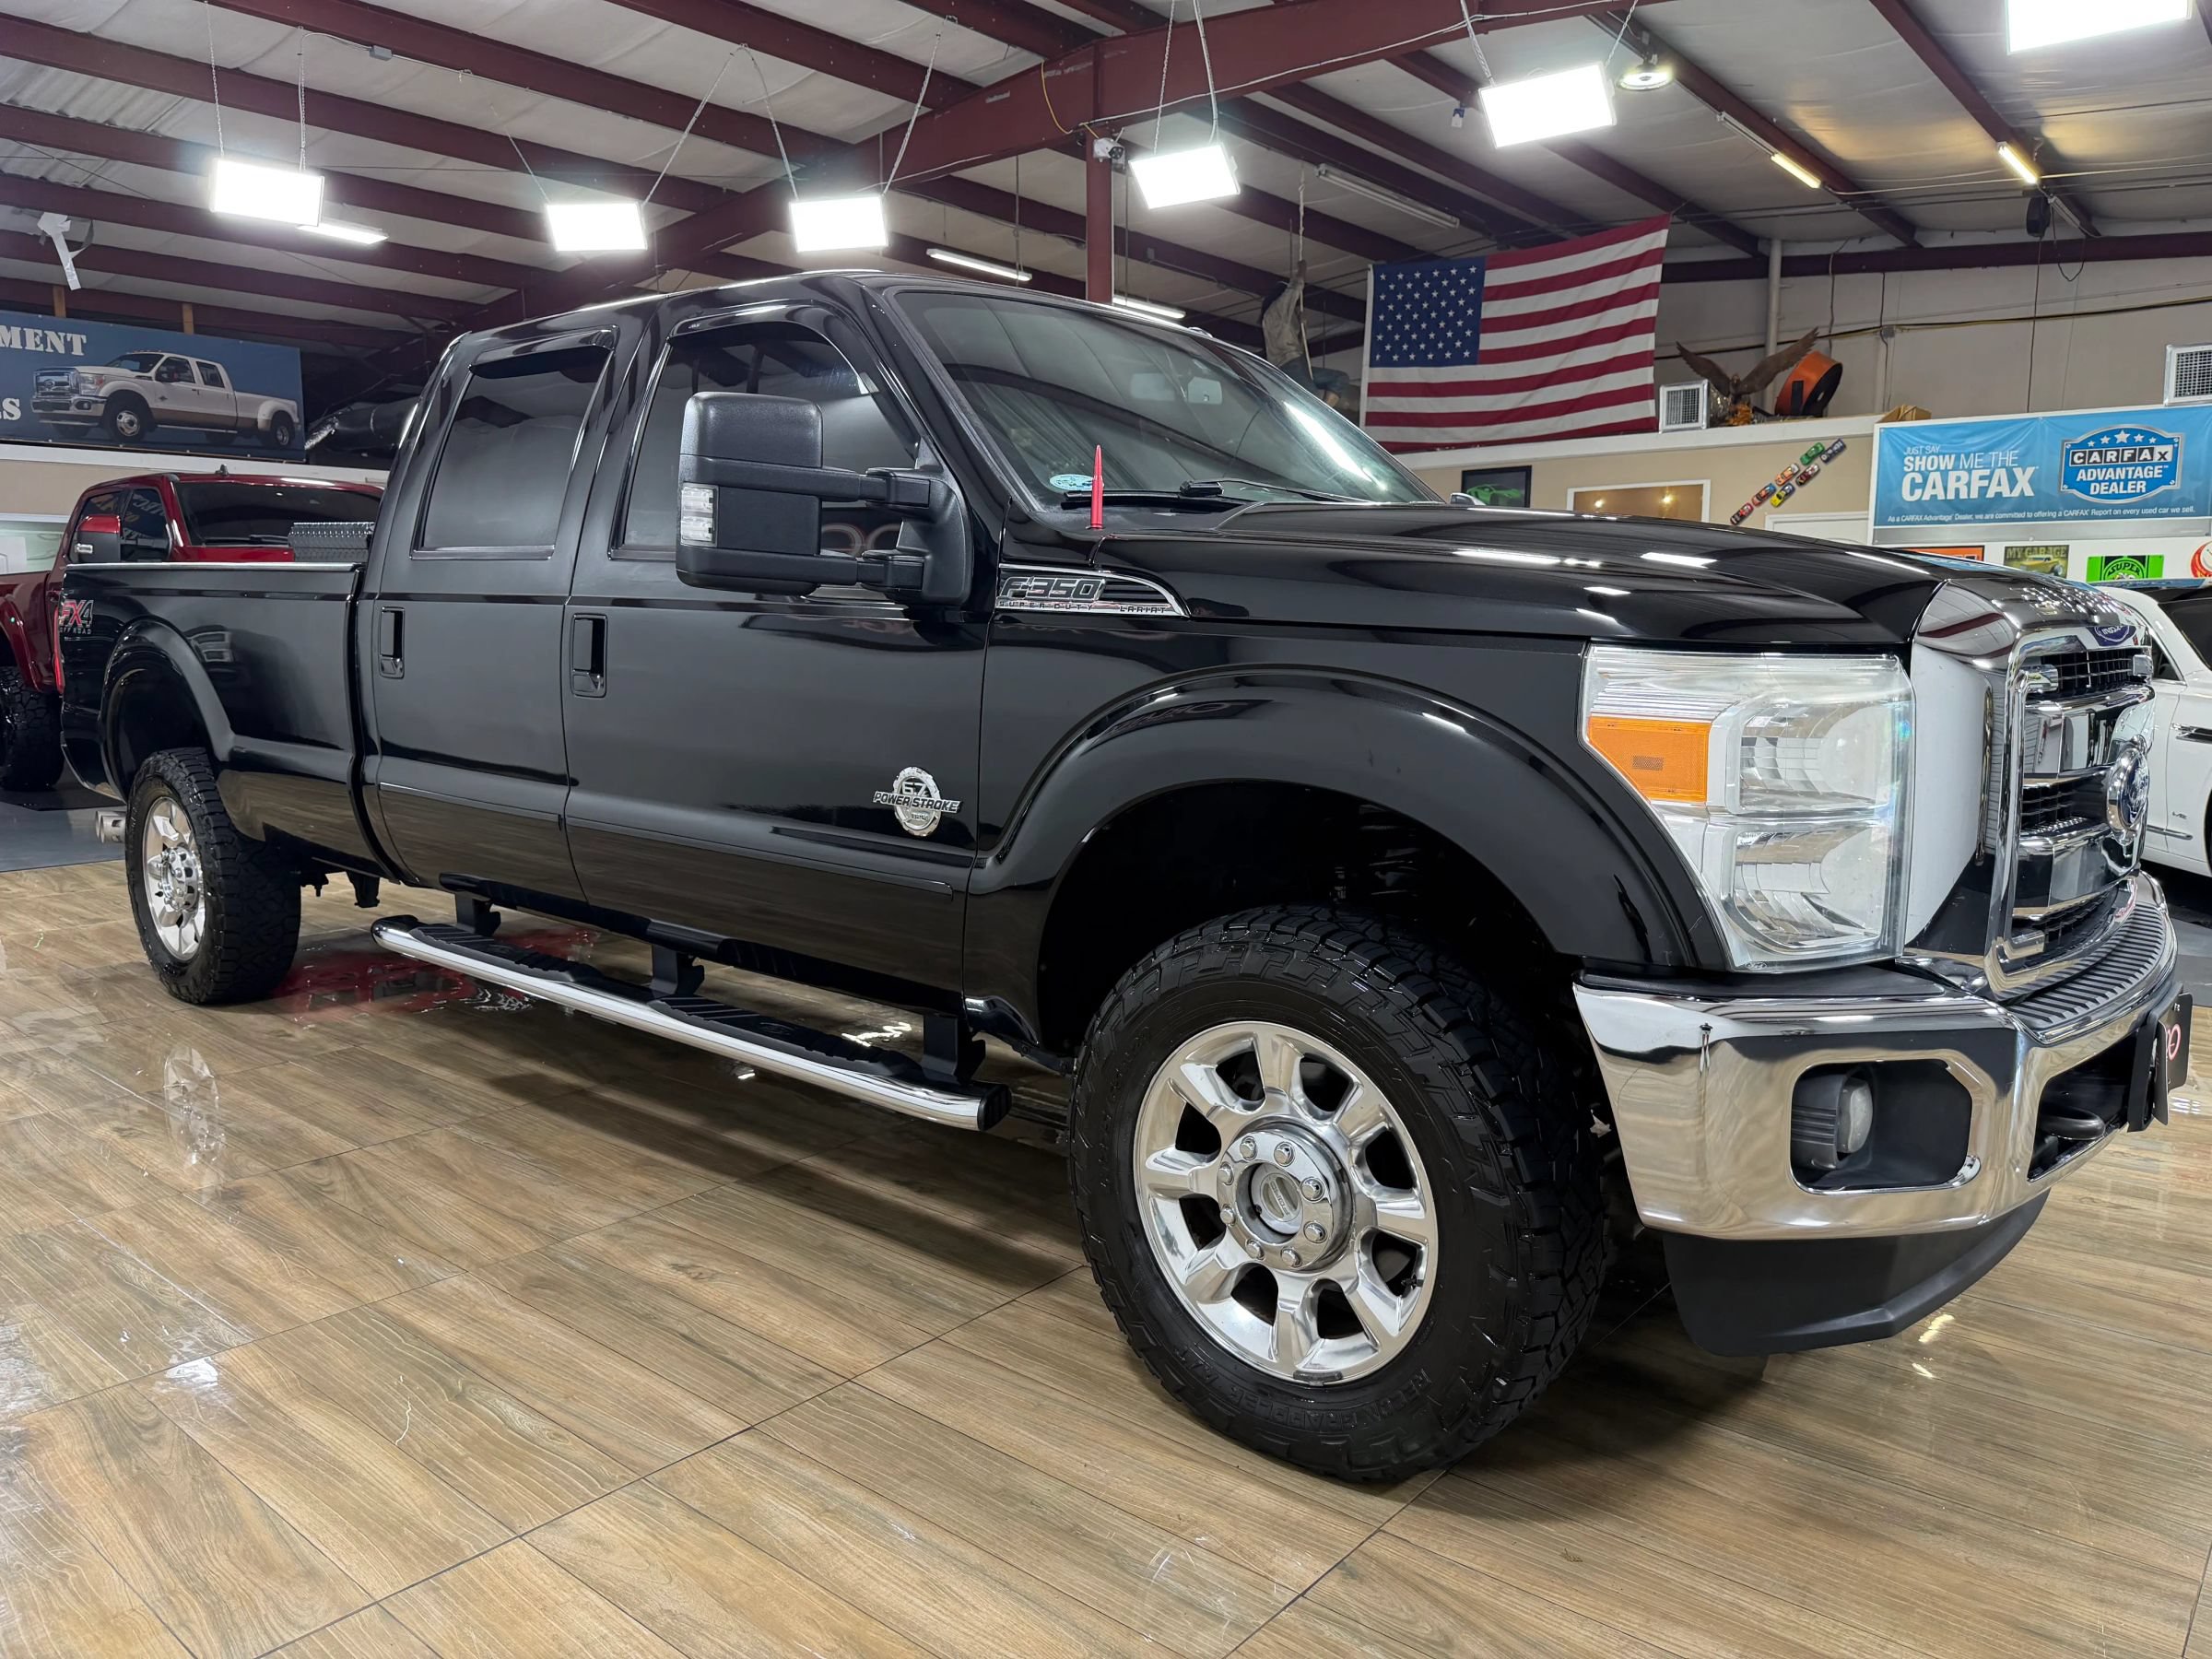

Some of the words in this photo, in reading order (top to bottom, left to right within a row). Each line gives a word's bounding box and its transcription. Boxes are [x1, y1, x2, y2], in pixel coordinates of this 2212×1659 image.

[1903, 445, 1924, 455] JUST
[1925, 444, 1941, 454] SAY
[2073, 447, 2169, 464] CARFAX
[1903, 454, 1956, 472] SHOW
[1959, 453, 1984, 469] ME
[1988, 450, 2019, 467] THE
[1901, 466, 2036, 501] CARFAX
[2089, 480, 2147, 495] DEALER
[2091, 509, 2112, 517] Report
[2006, 547, 2023, 559] MY
[2025, 546, 2067, 558] GARAGE
[2108, 562, 2140, 576] SUPER
[61, 599, 94, 628] FX4
[999, 600, 1046, 609] SUPER
[1053, 603, 1093, 611] DUTY
[1119, 605, 1166, 614] LARIAT
[874, 792, 911, 807] POWER
[912, 796, 960, 812] STROKE
